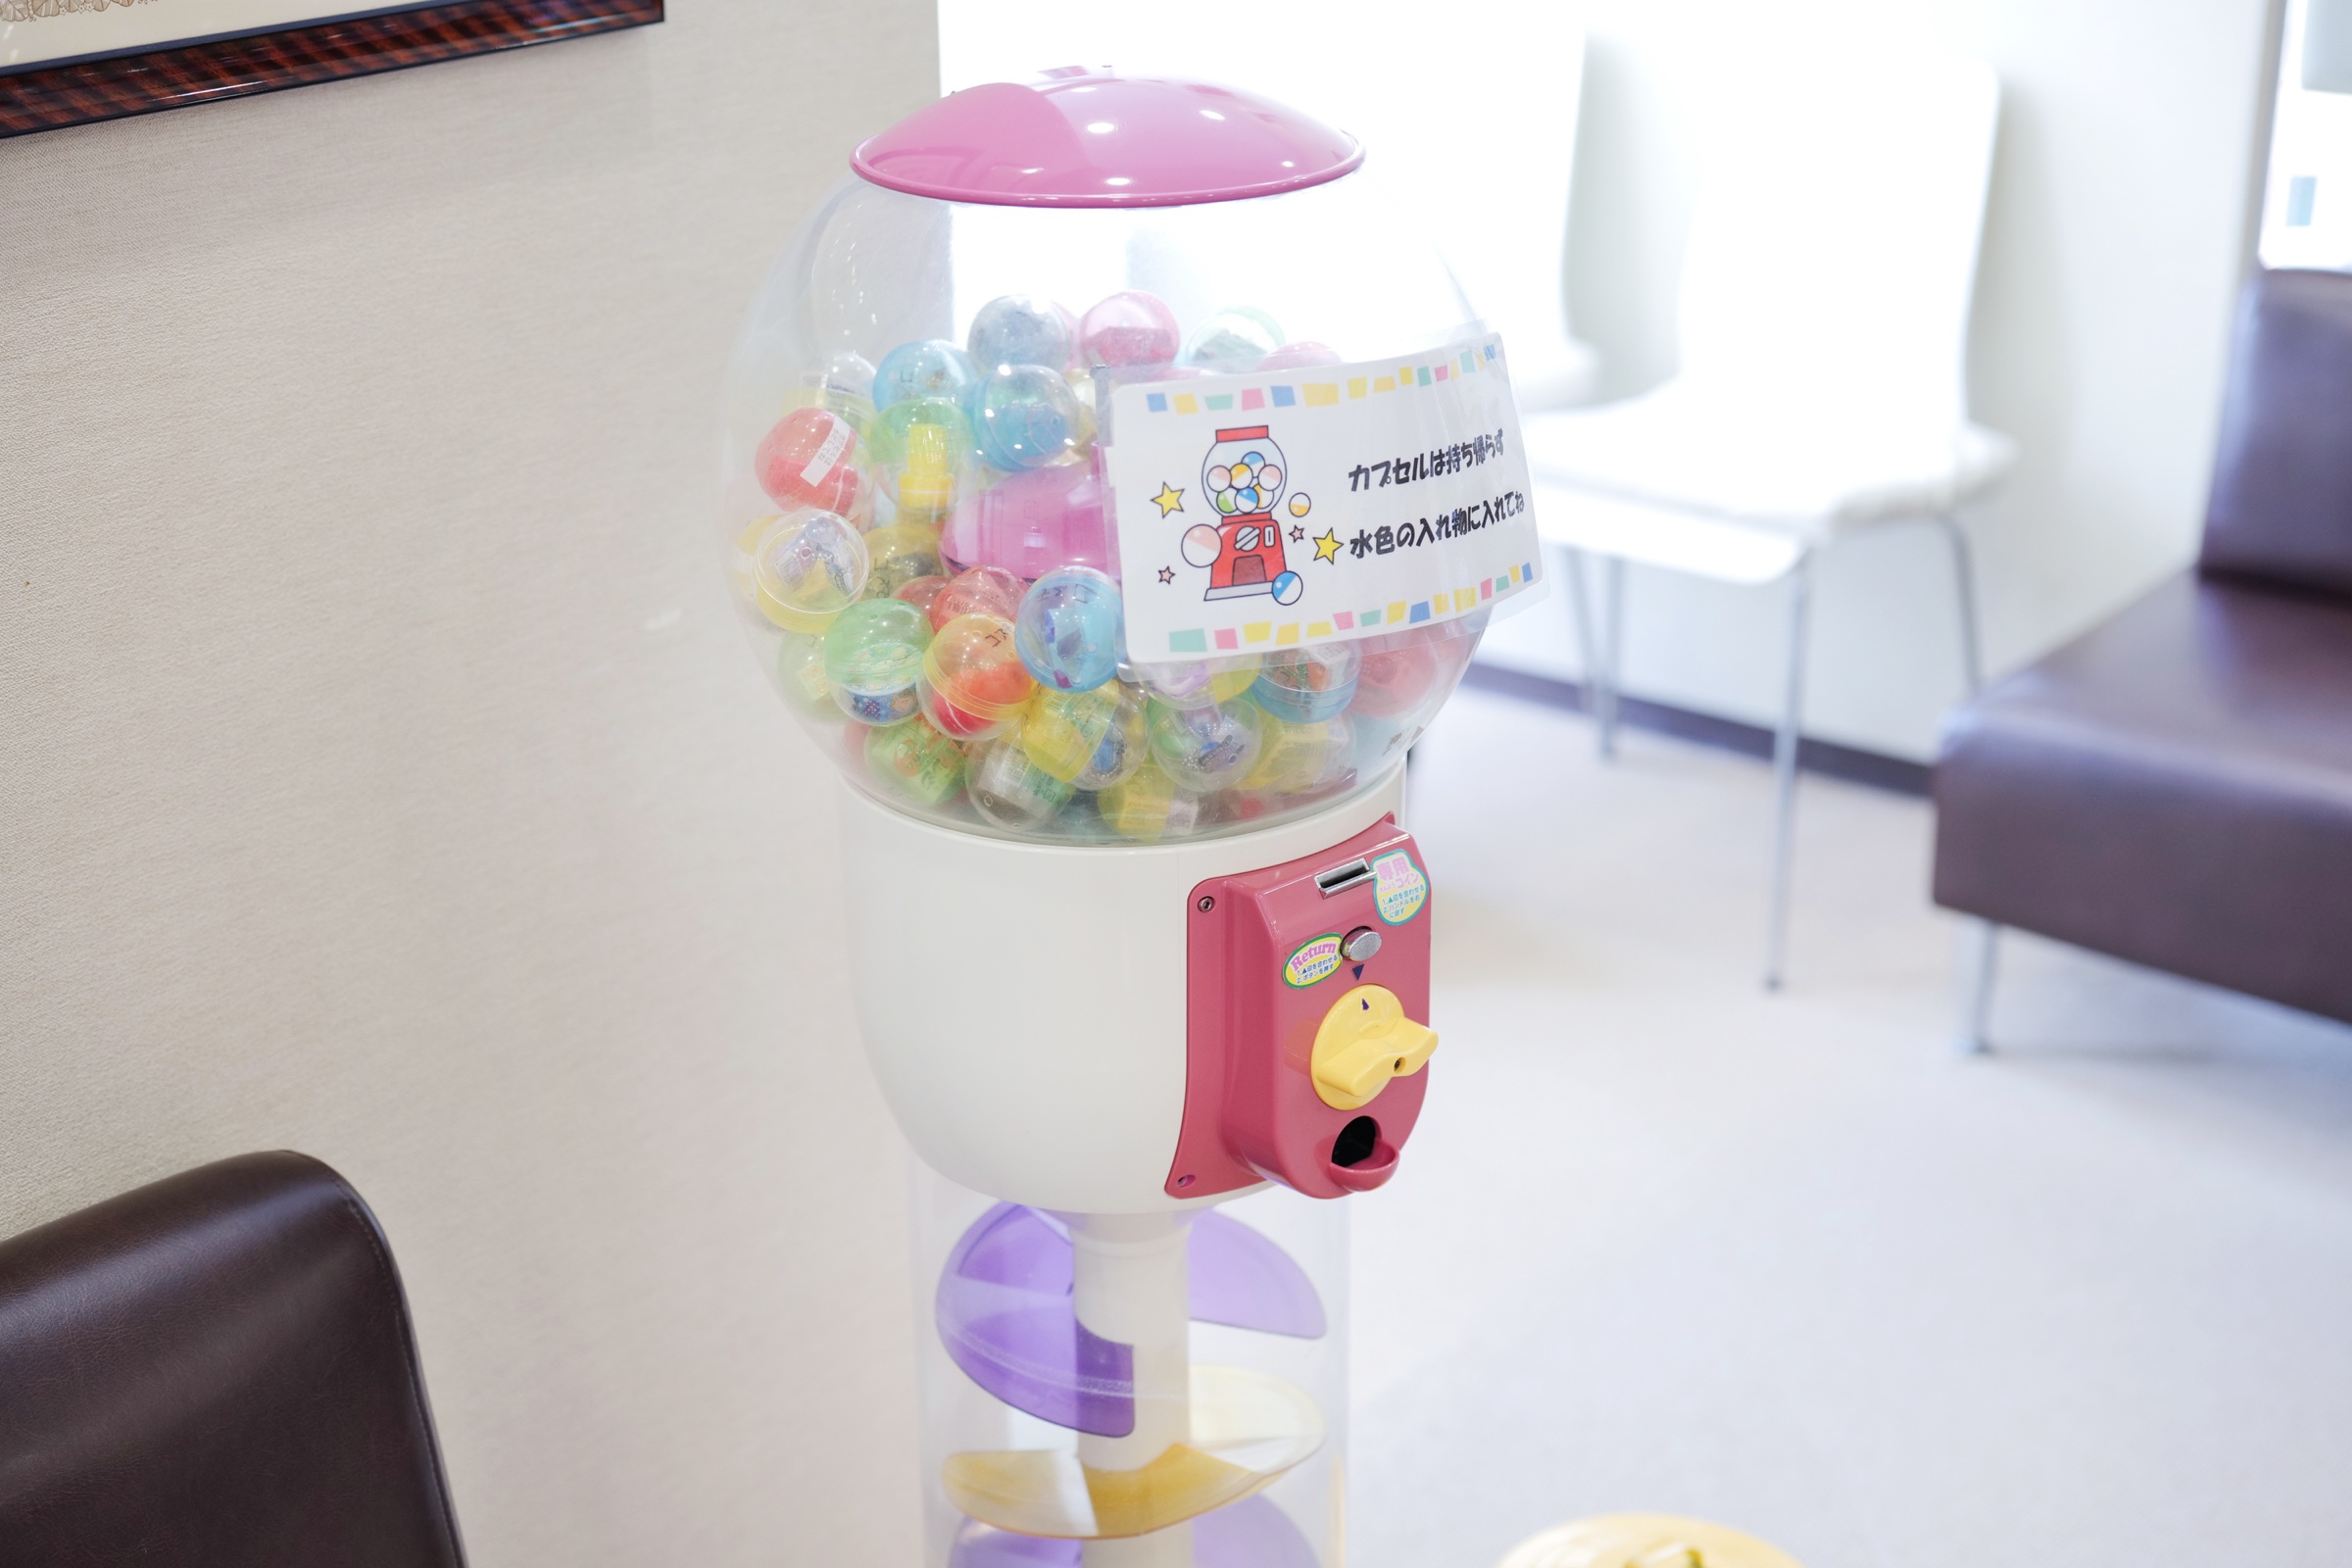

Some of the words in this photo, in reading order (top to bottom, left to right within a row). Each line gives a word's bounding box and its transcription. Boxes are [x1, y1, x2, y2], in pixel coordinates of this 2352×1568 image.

[1348, 428, 1503, 492] カプセルは持ち帰らず
[1350, 491, 1524, 559] 水色の入れ物に入れてね
[1376, 857, 1409, 881] 専用
[1291, 943, 1337, 971] Return
